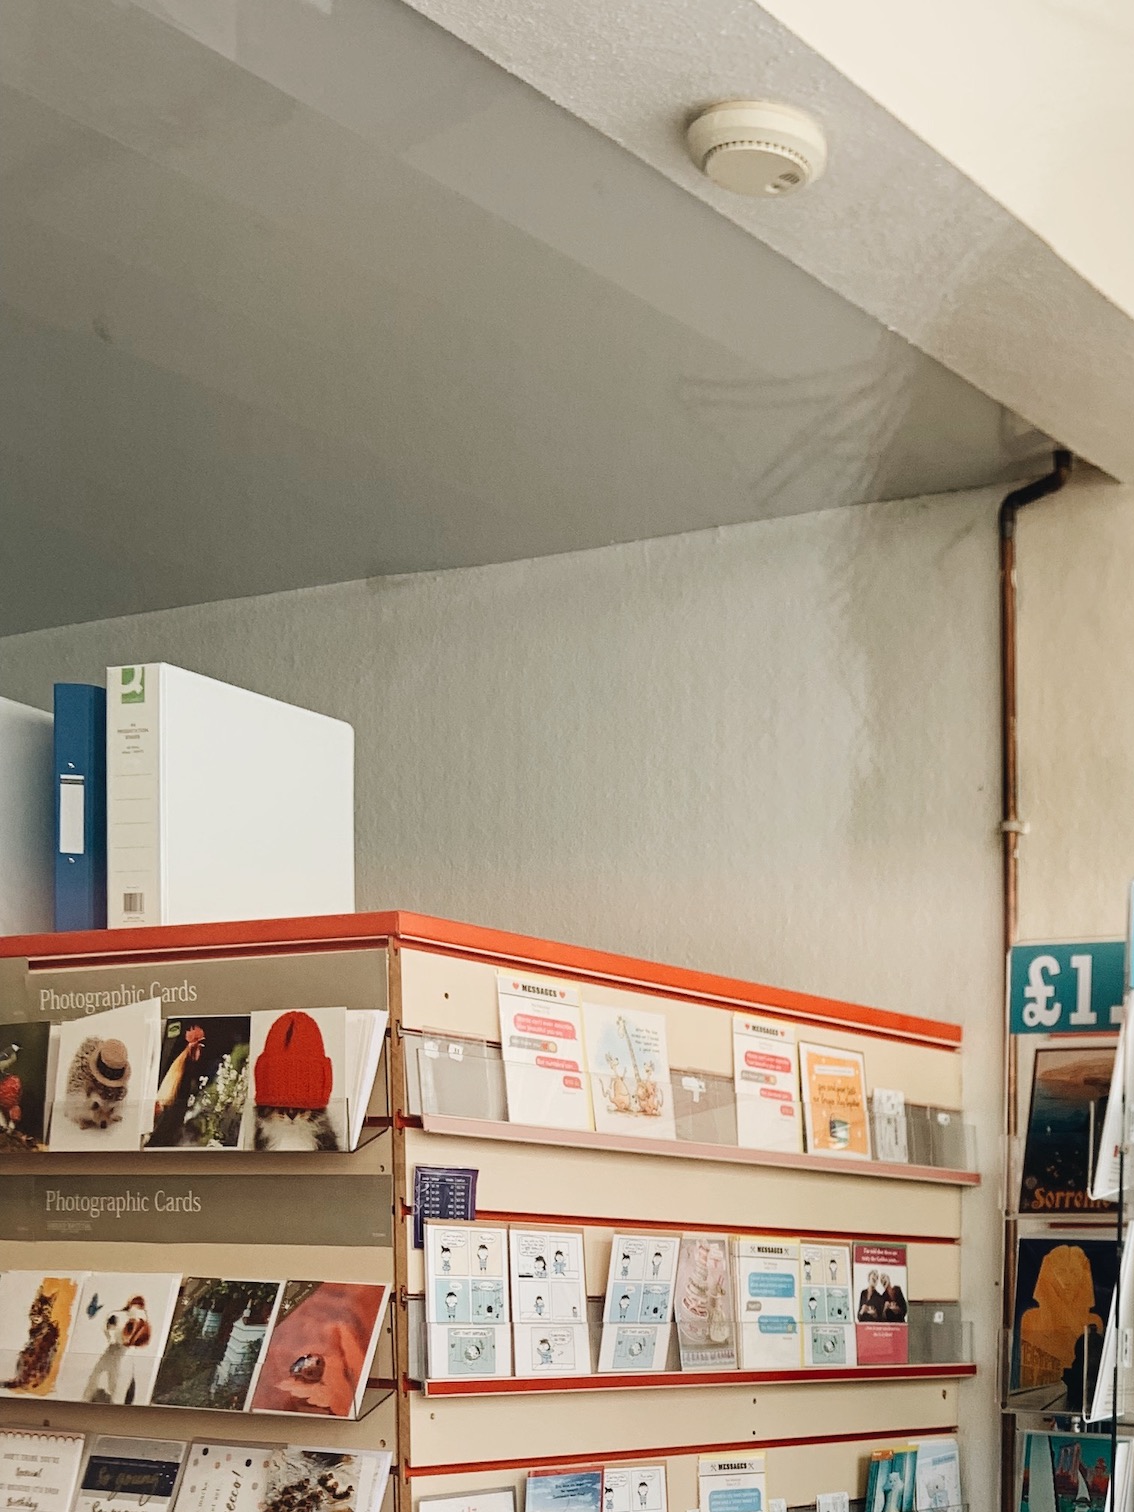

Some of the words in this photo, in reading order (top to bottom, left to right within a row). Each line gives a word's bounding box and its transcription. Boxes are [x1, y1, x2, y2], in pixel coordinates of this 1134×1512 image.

[40, 984, 145, 1014] Photographic
[150, 980, 197, 1003] Cards
[521, 984, 558, 998] MESSAGES
[1023, 954, 1125, 1028] £1.
[46, 1190, 150, 1218] Photographic
[154, 1190, 202, 1212] Cards
[718, 1462, 747, 1471] MESSAGES
